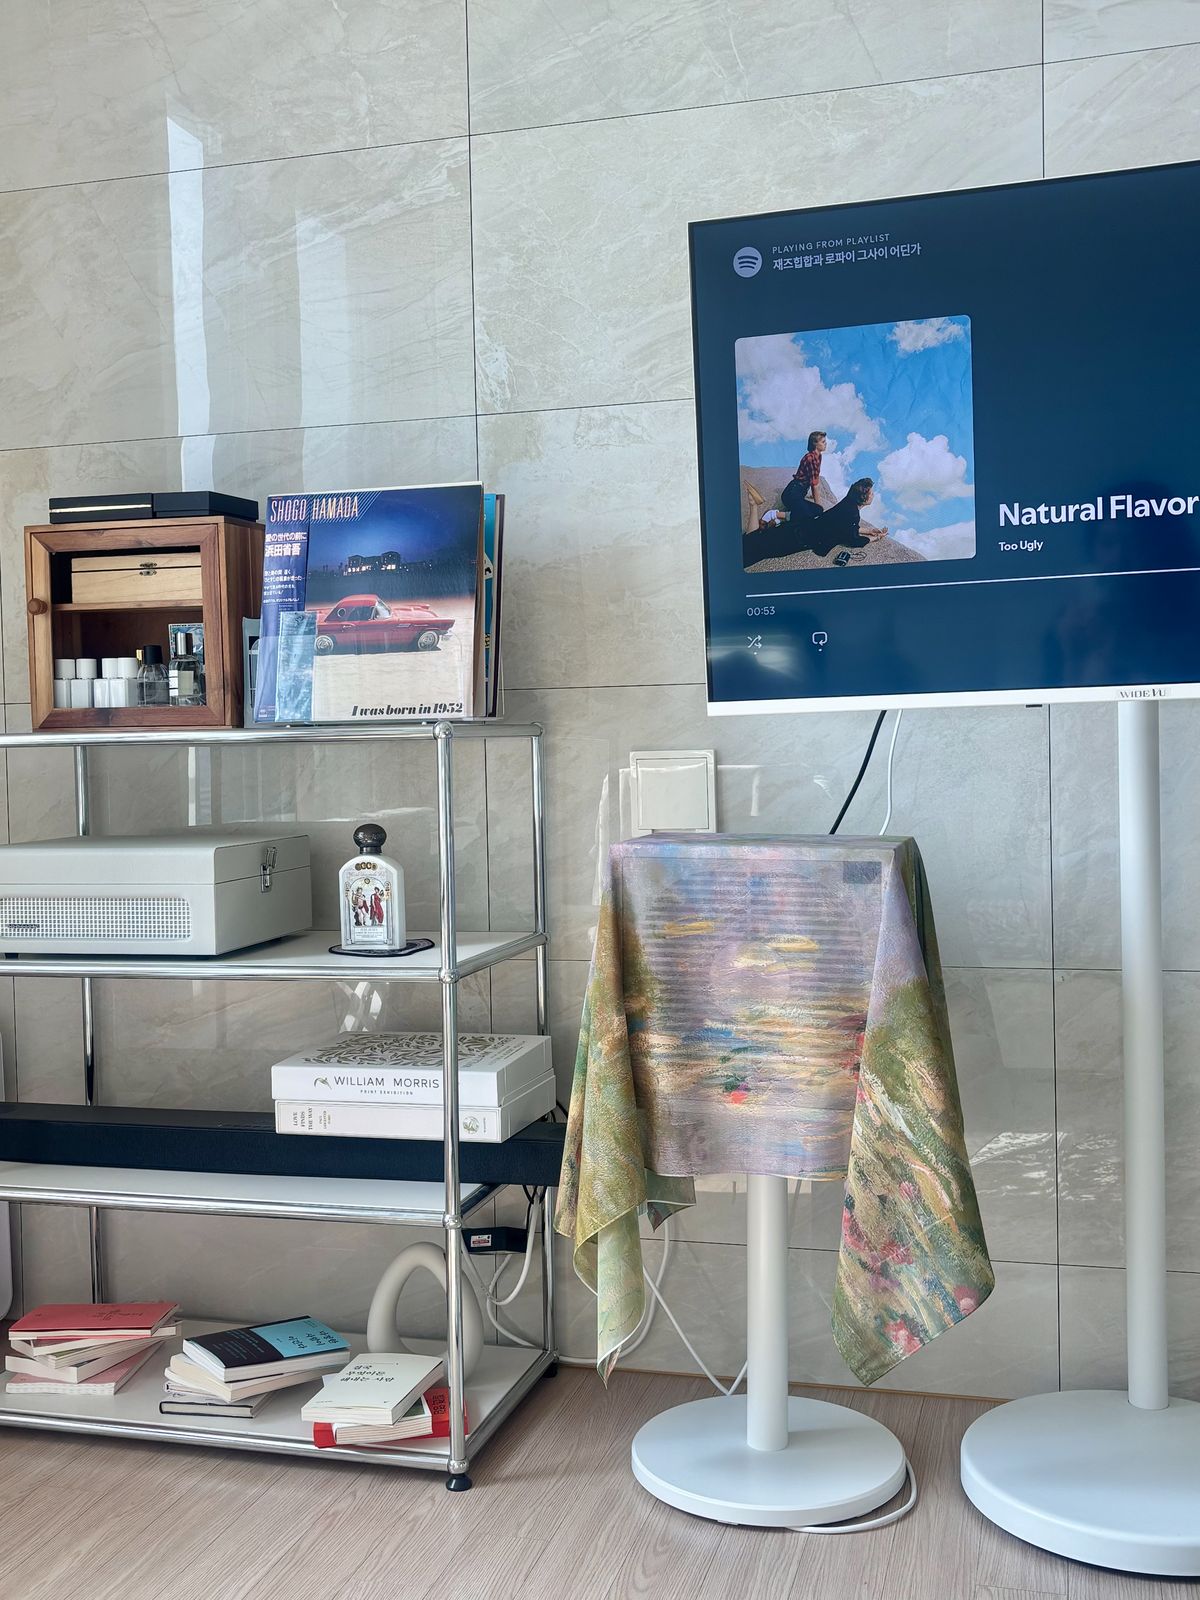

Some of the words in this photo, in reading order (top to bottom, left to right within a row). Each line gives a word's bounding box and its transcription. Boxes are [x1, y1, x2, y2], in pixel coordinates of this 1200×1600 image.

[772, 242, 813, 254] PLAYING
[816, 239, 843, 249] FROM
[846, 233, 890, 246] PLAYLIST
[773, 253, 824, 271] 재즈힙합과
[825, 250, 856, 265] 로파이
[857, 246, 888, 261] 그사이
[889, 242, 922, 258] 어딘가
[270, 499, 307, 522] SHOGO
[312, 495, 359, 520] HAMADA
[999, 496, 1103, 526] Natural
[1110, 494, 1200, 519] Flavor
[998, 541, 1018, 552] Too
[1019, 539, 1044, 552] Ugly
[746, 606, 776, 617] 00:53
[351, 705, 359, 717] I
[359, 707, 385, 717] was
[385, 704, 416, 716] born
[418, 703, 432, 715] in
[433, 702, 463, 714] 1952
[334, 1075, 385, 1087] WILLIAM
[393, 1077, 440, 1089] MORRIS
